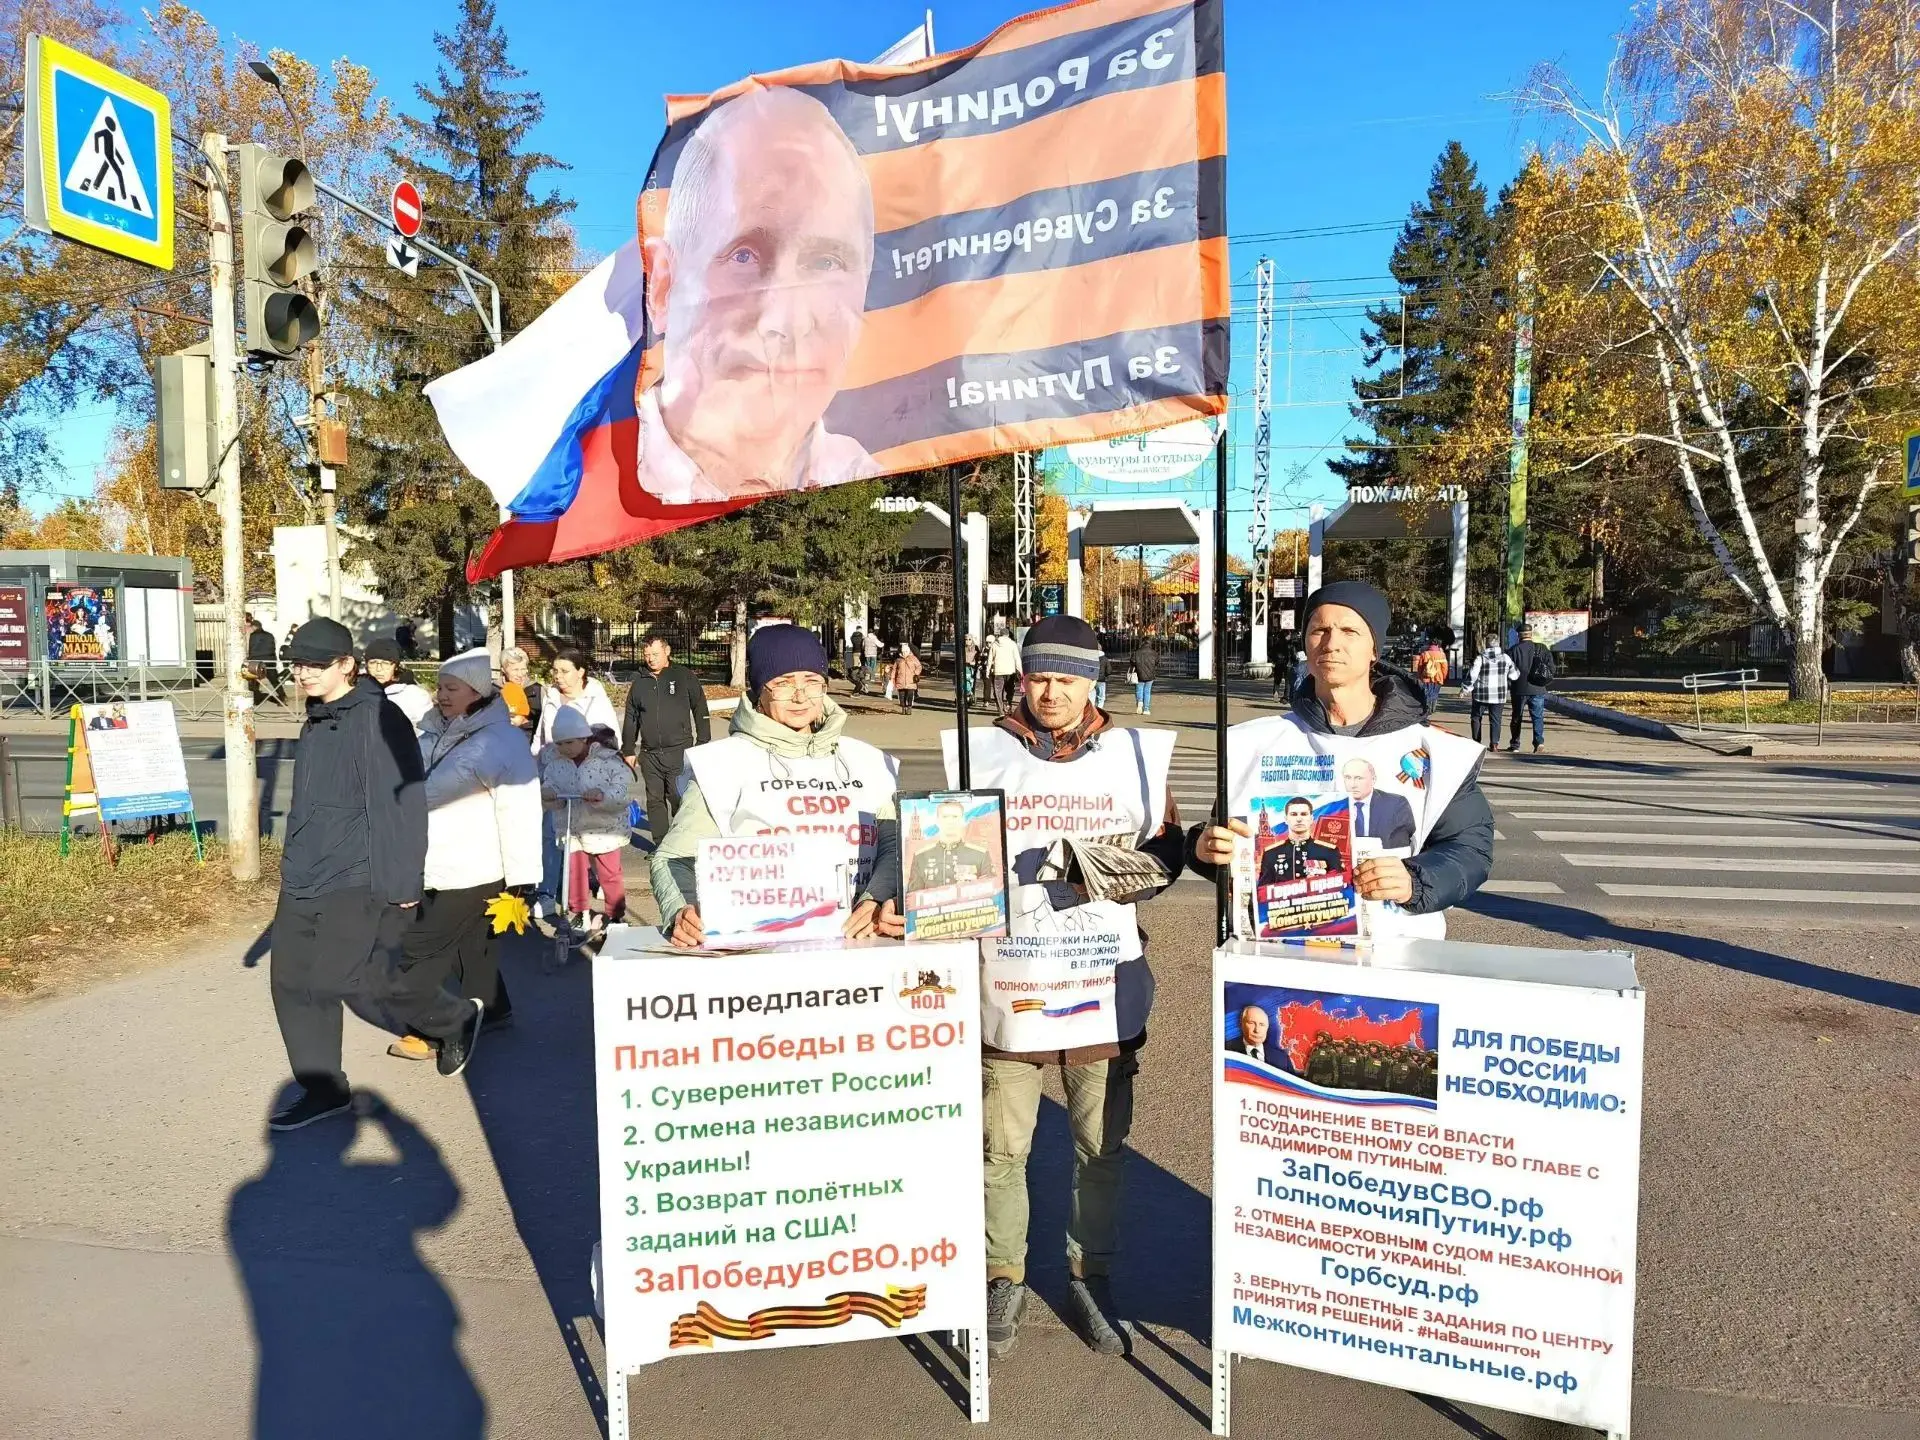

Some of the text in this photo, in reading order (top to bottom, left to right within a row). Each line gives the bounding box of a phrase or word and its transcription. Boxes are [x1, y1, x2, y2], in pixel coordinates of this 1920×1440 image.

[1077, 454, 1139, 468] культуры
[1153, 453, 1202, 465] отдыха
[870, 496, 917, 512] ОБРО
[1350, 485, 1468, 503] ПОЖАЛОАТЬ
[63, 642, 104, 654] МАГИИ
[786, 795, 851, 816] СБОР
[1006, 793, 1113, 812] НАРОДНЫЙ
[1006, 816, 1032, 832] ОР
[709, 843, 795, 861] РОССИЯ!
[731, 886, 825, 909] ПОБЕДА!
[997, 946, 1120, 958] РАБОТАТЬ НЕВОЗМОЖНО!
[1016, 935, 1080, 947] ПОДДЕРЖКИ
[1083, 934, 1120, 944] НАРОДА
[627, 985, 884, 1022] НОД предлагает
[911, 994, 945, 1009] НОД
[615, 1021, 964, 1071] План Победы в СВО!
[1452, 1028, 1620, 1064] ДЛЯ ПОБЕДЫ
[621, 1066, 932, 1111] 1. Суверенитет России!
[1484, 1055, 1587, 1084] РОССИИ
[1446, 1075, 1626, 1114] НЕОБХОДИМО:
[623, 1103, 962, 1146] 2. Отмена независимости
[1240, 1098, 1515, 1150] 1. ПОДЧИНЕНИЕ ВЕТВЕЙ ВЛАСТИ
[624, 1150, 750, 1182] Украины!
[1239, 1131, 1447, 1176] ВЛАДИМИРОМ ПУТИНЫМ.
[1240, 1114, 1600, 1180] ГОСУДАРСТВЕННОМУ СОВЕТУ ВО ГЛАВЕ С
[625, 1178, 904, 1216] 3. Возврат полётных
[1282, 1157, 1544, 1222] ЗаПобедувСВО.рф
[625, 1213, 856, 1253] заданий на США!
[1257, 1177, 1572, 1252] ПолномочияПутину.рф
[1234, 1205, 1624, 1285] 2. ОТМЕНА ВЕРХОВНЫМ СУДОМ НЕЗАКОННОЙ
[1234, 1222, 1467, 1276] НЕЗАВИСИМОСТИ УКРАИНЫ.
[634, 1237, 957, 1293] ЗаПобедувСВО.рф
[1321, 1256, 1479, 1307] Горбсуд.рф
[1233, 1272, 1614, 1355] 3. ВЕРНУТЬ ПОЛЕТНЫЕ ЗАДАНИЯ ПО ЦЕНТРУ
[1233, 1288, 1317, 1315] ПРИНЯТИЯ
[1322, 1305, 1403, 1333] РЕШЕНИЙ
[1417, 1325, 1541, 1359] #НаВашингтон
[1233, 1305, 1578, 1394] Межконтинентальные.рф
